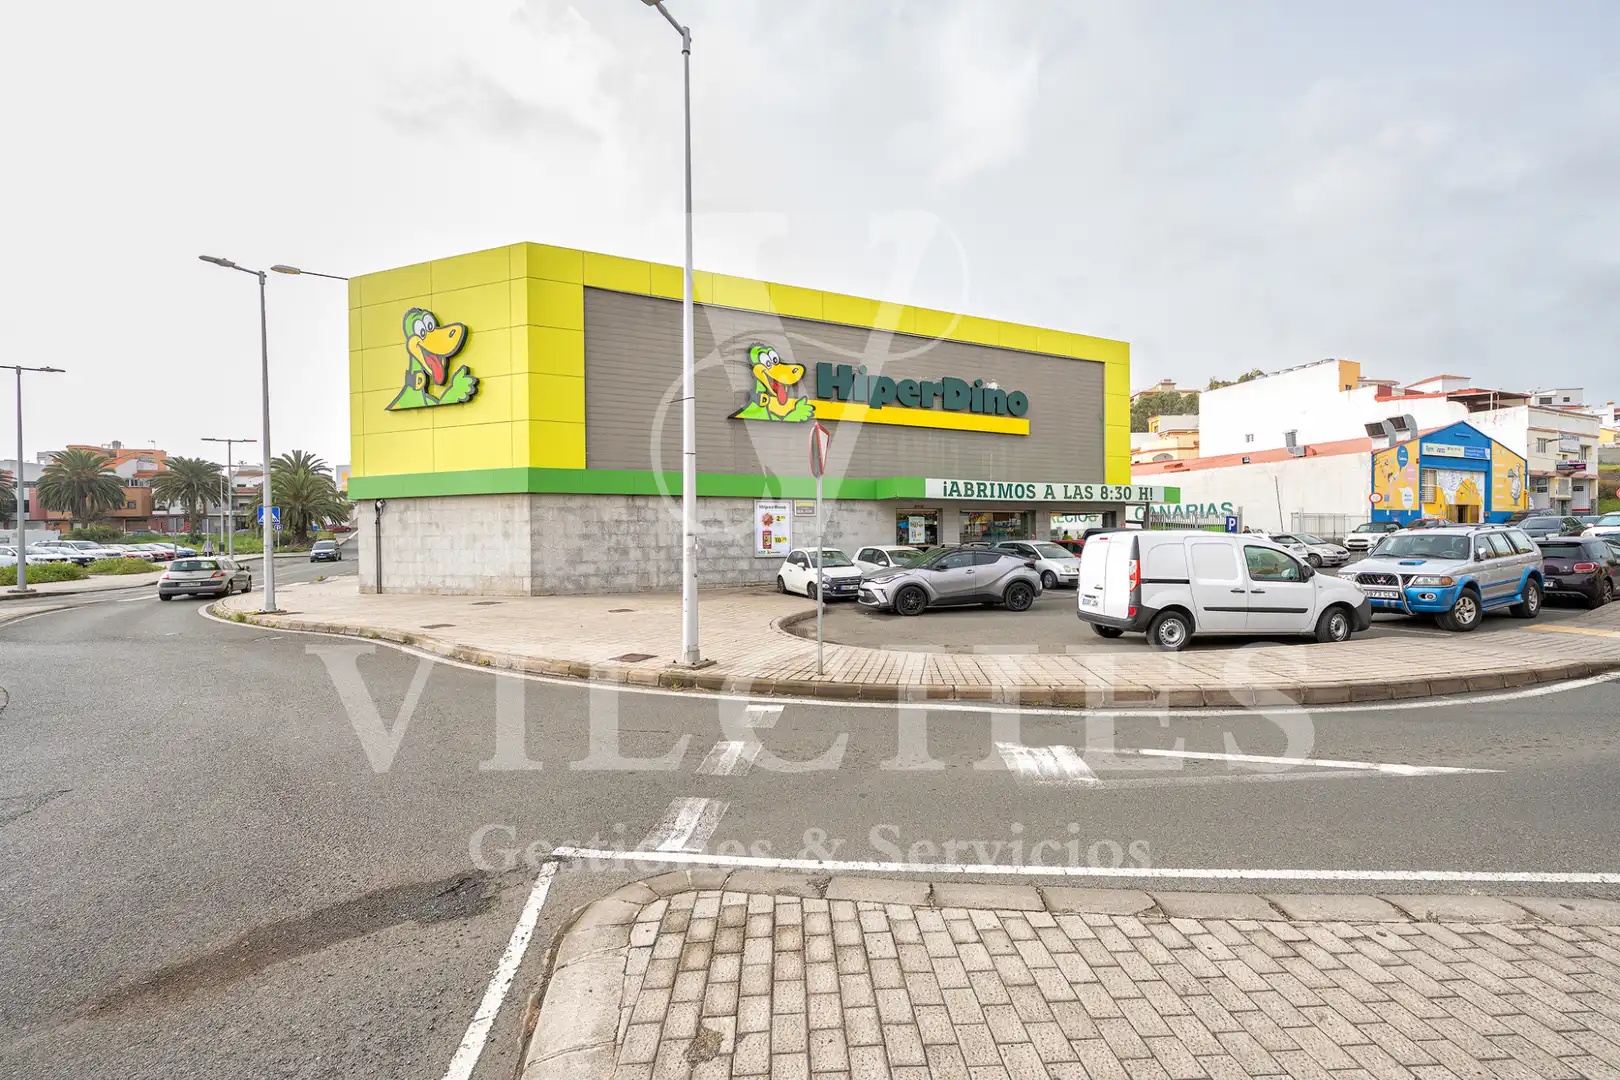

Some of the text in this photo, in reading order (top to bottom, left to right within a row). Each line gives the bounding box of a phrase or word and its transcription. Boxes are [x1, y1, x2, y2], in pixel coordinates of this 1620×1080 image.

[816, 362, 1029, 417] HiperDino
[1043, 484, 1056, 500] A
[1063, 485, 1094, 500] LAS
[1100, 486, 1132, 501] 8:30
[1138, 487, 1153, 501] H!
[1135, 502, 1233, 521] CANARIAS
[1228, 517, 1237, 531] P
